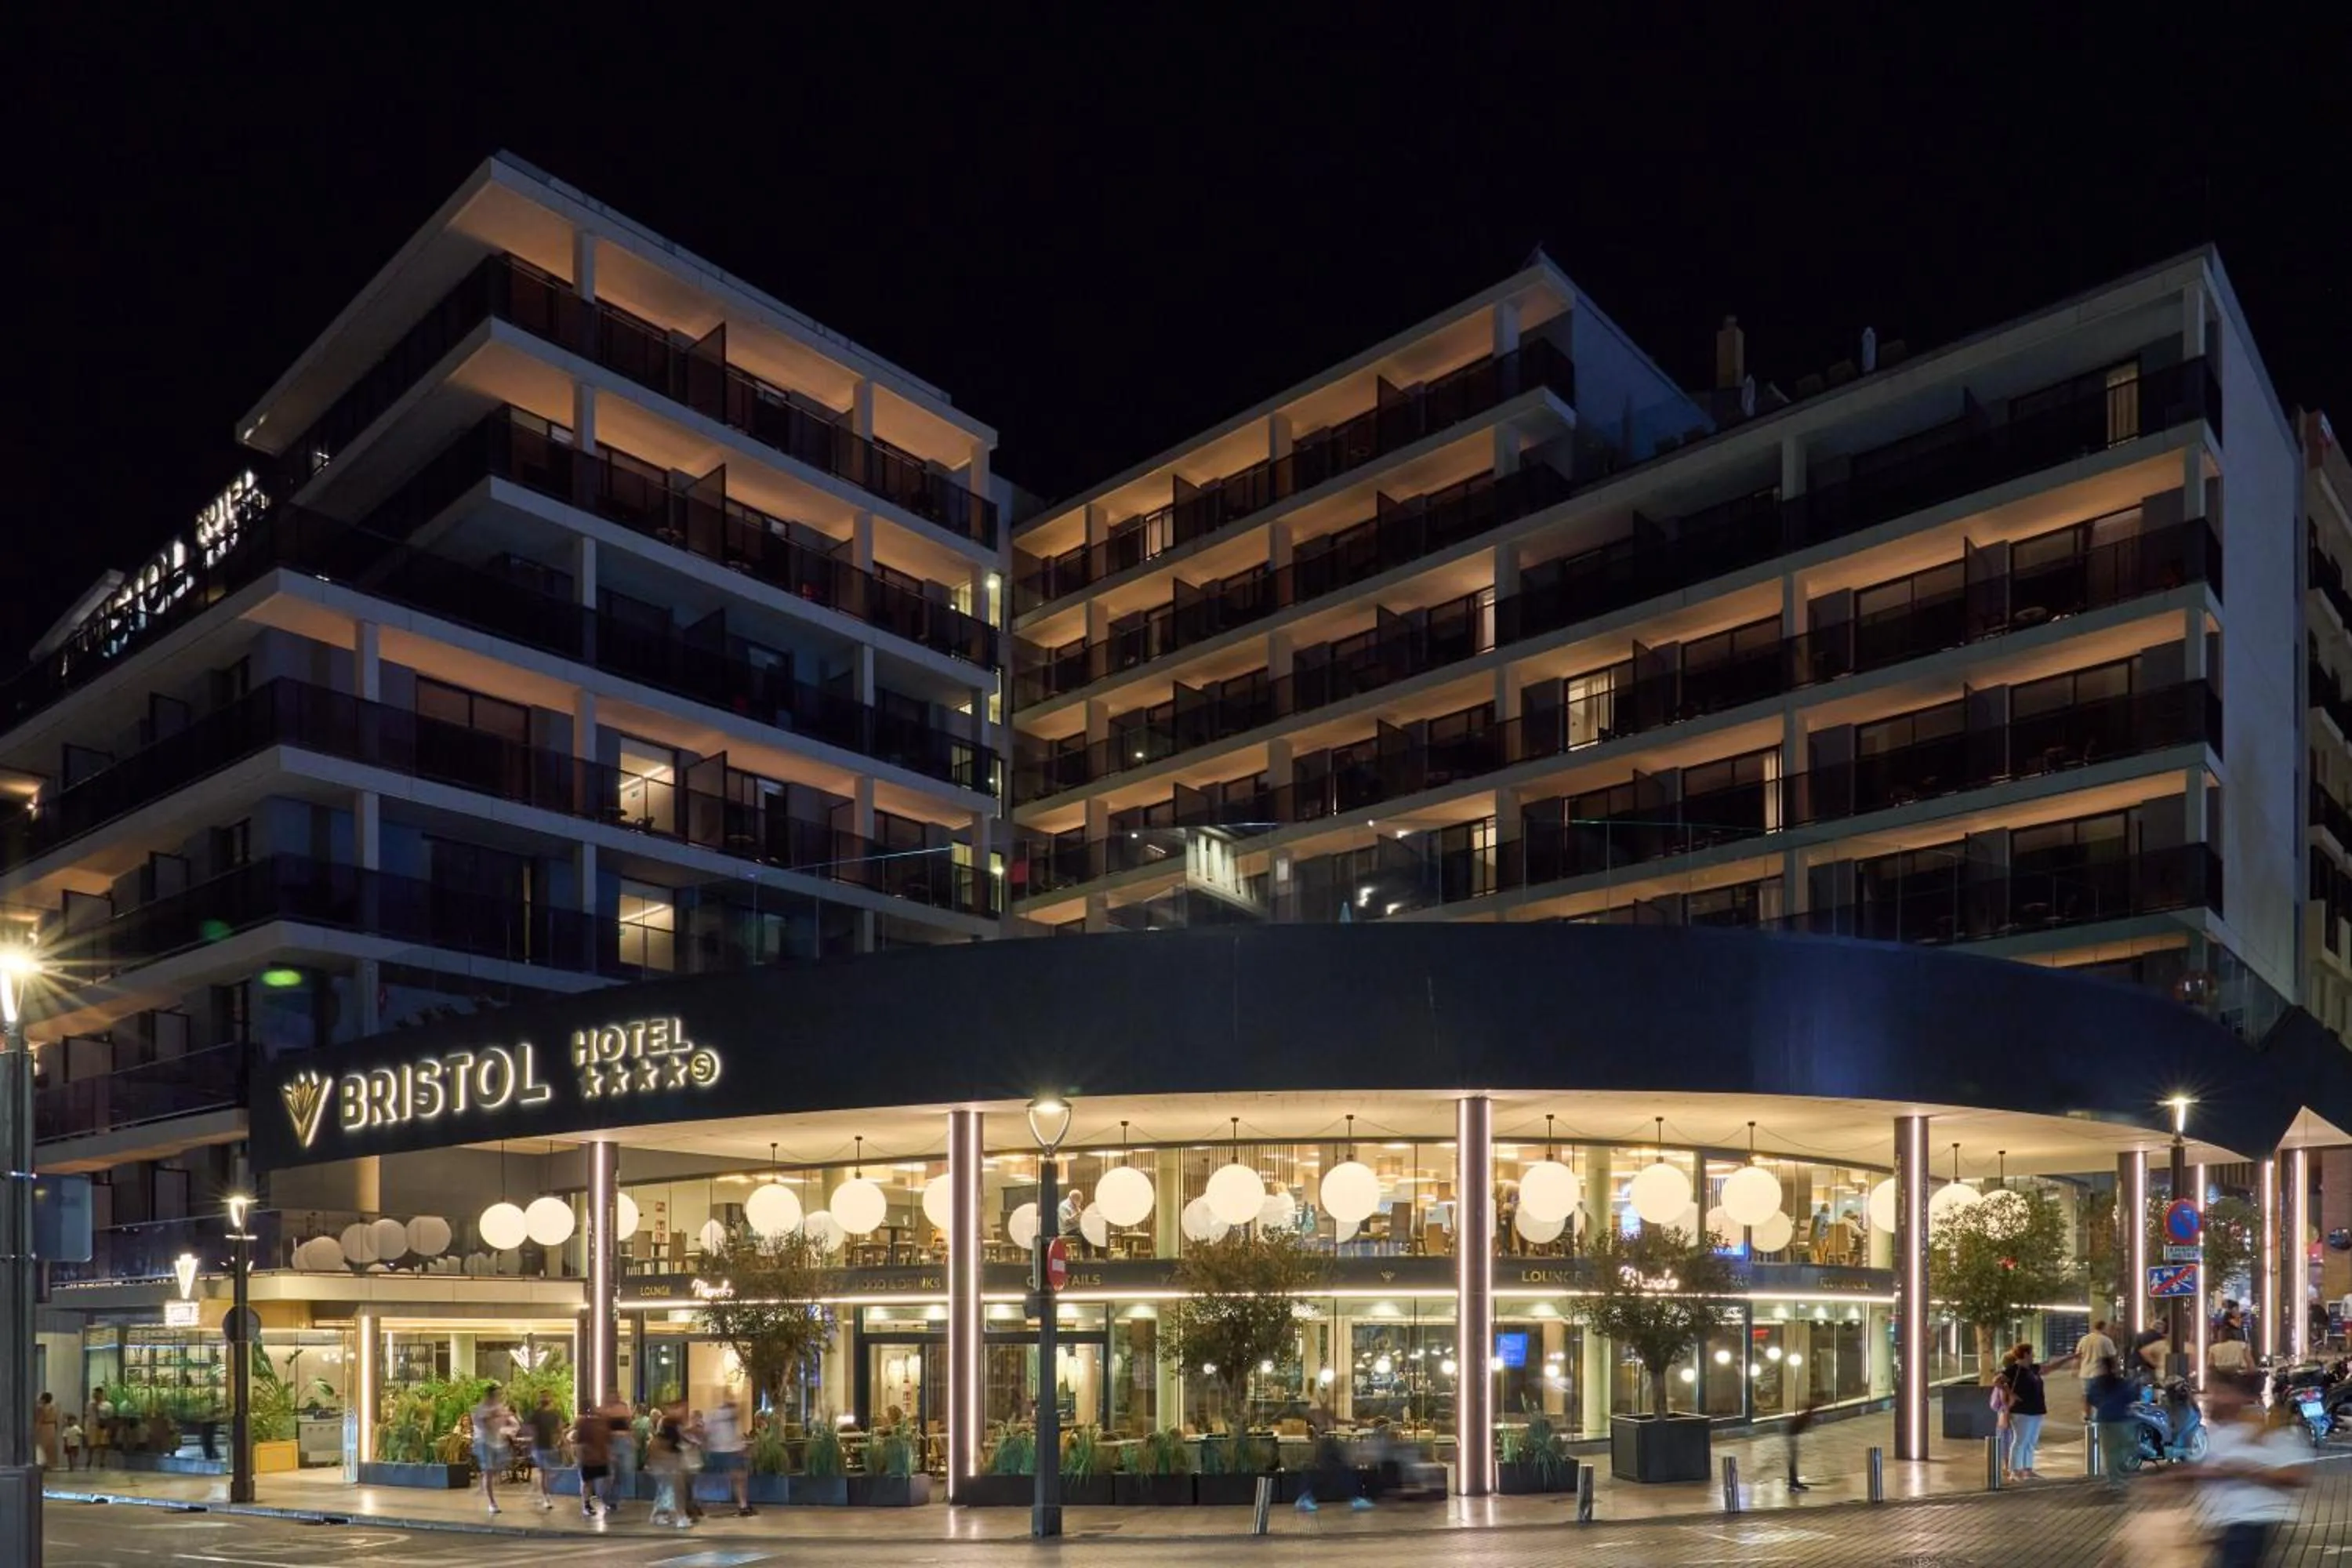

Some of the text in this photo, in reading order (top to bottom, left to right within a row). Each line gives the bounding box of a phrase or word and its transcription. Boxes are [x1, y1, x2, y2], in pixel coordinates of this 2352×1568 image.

[572, 1017, 693, 1067] HOTEL
[339, 1044, 551, 1131] BRISTOL
[1026, 1273, 1102, 1287] CTAILS
[1522, 1270, 1582, 1283] LOUNGE
